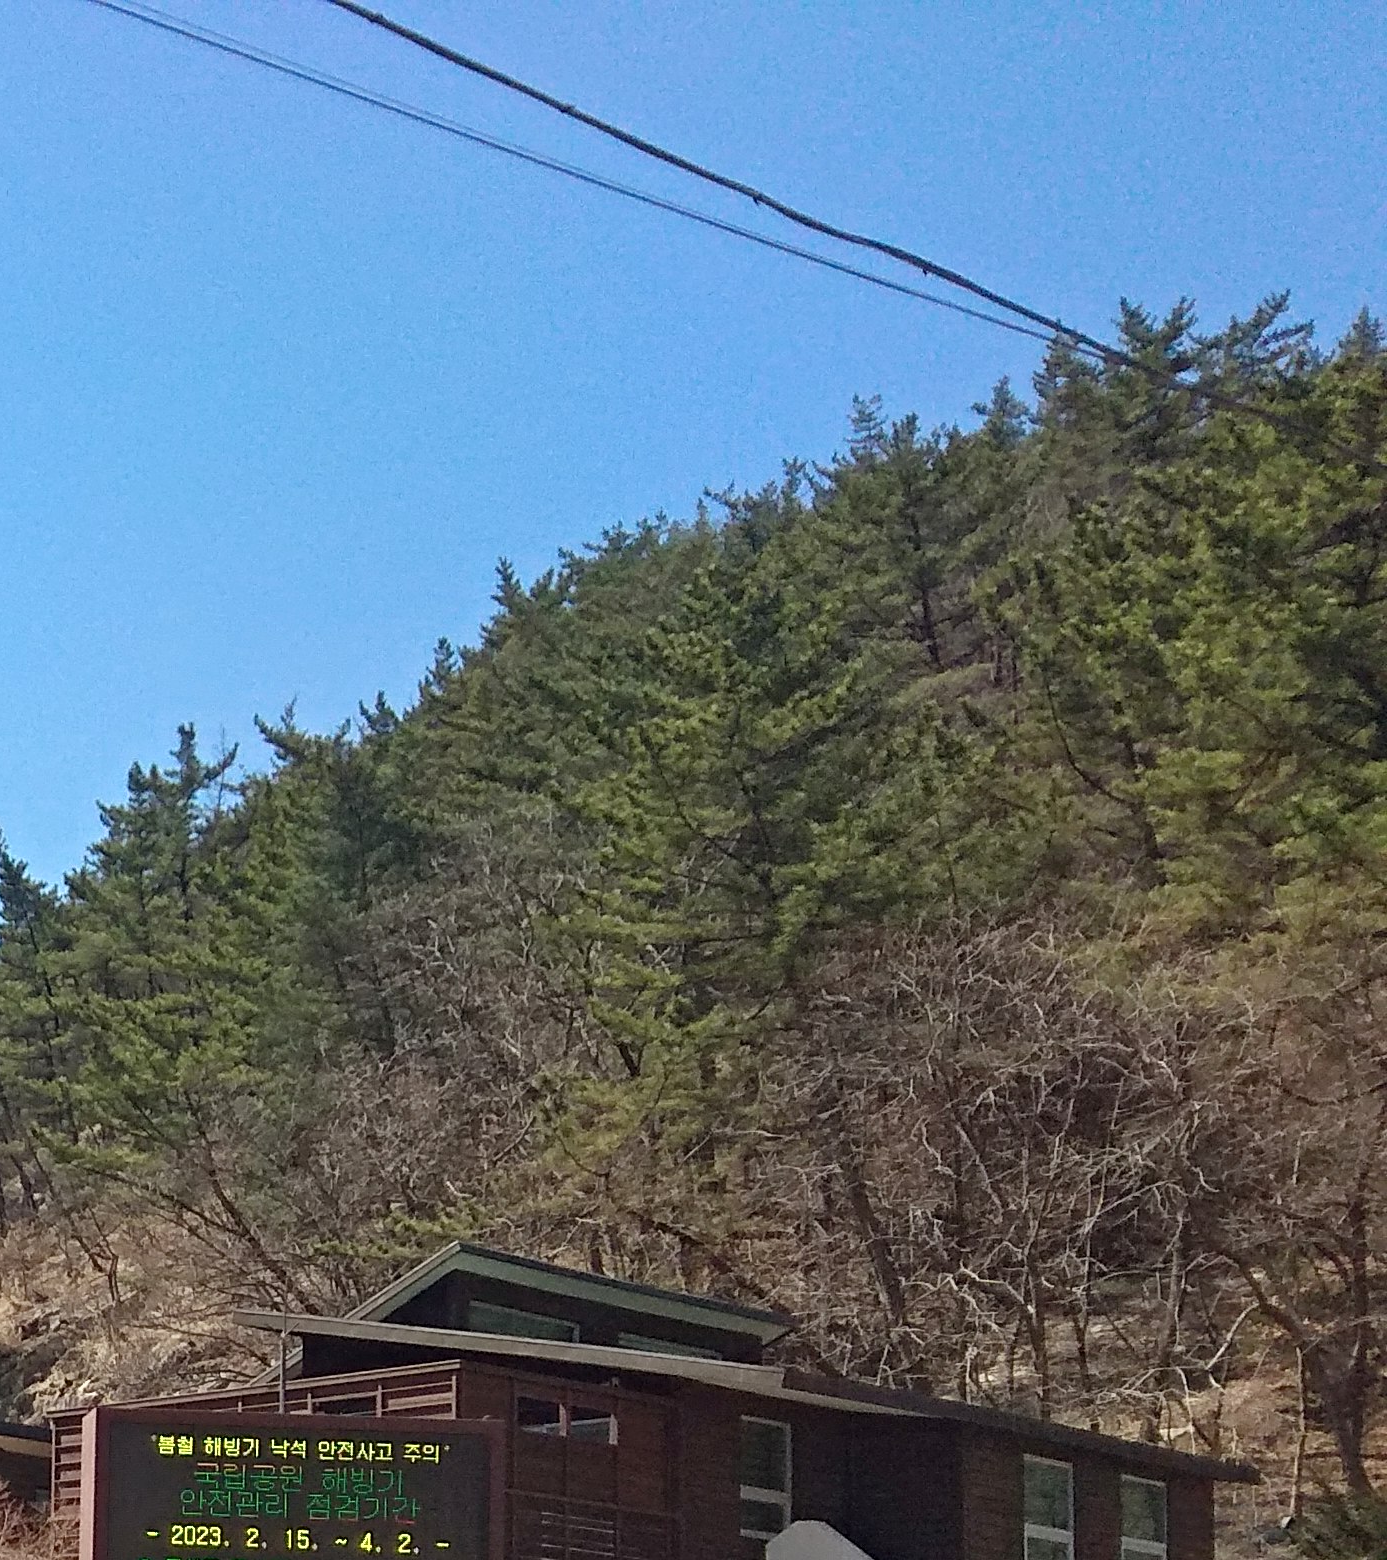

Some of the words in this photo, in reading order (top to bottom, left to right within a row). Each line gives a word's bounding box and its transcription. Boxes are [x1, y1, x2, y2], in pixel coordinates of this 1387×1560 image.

[203, 1436, 260, 1457] 해빙기
[270, 1439, 307, 1459] 낙석
[318, 1440, 394, 1463] 안전사고
[193, 1461, 303, 1492] 국립공원
[321, 1467, 403, 1496] 해빙기
[180, 1488, 289, 1519] 안전관리
[306, 1493, 421, 1525] 점검기간
[171, 1525, 230, 1548] 2023.
[246, 1527, 268, 1549] 2.
[286, 1528, 319, 1551] 15.
[360, 1532, 382, 1554] 4.
[398, 1533, 420, 1555] 2.
